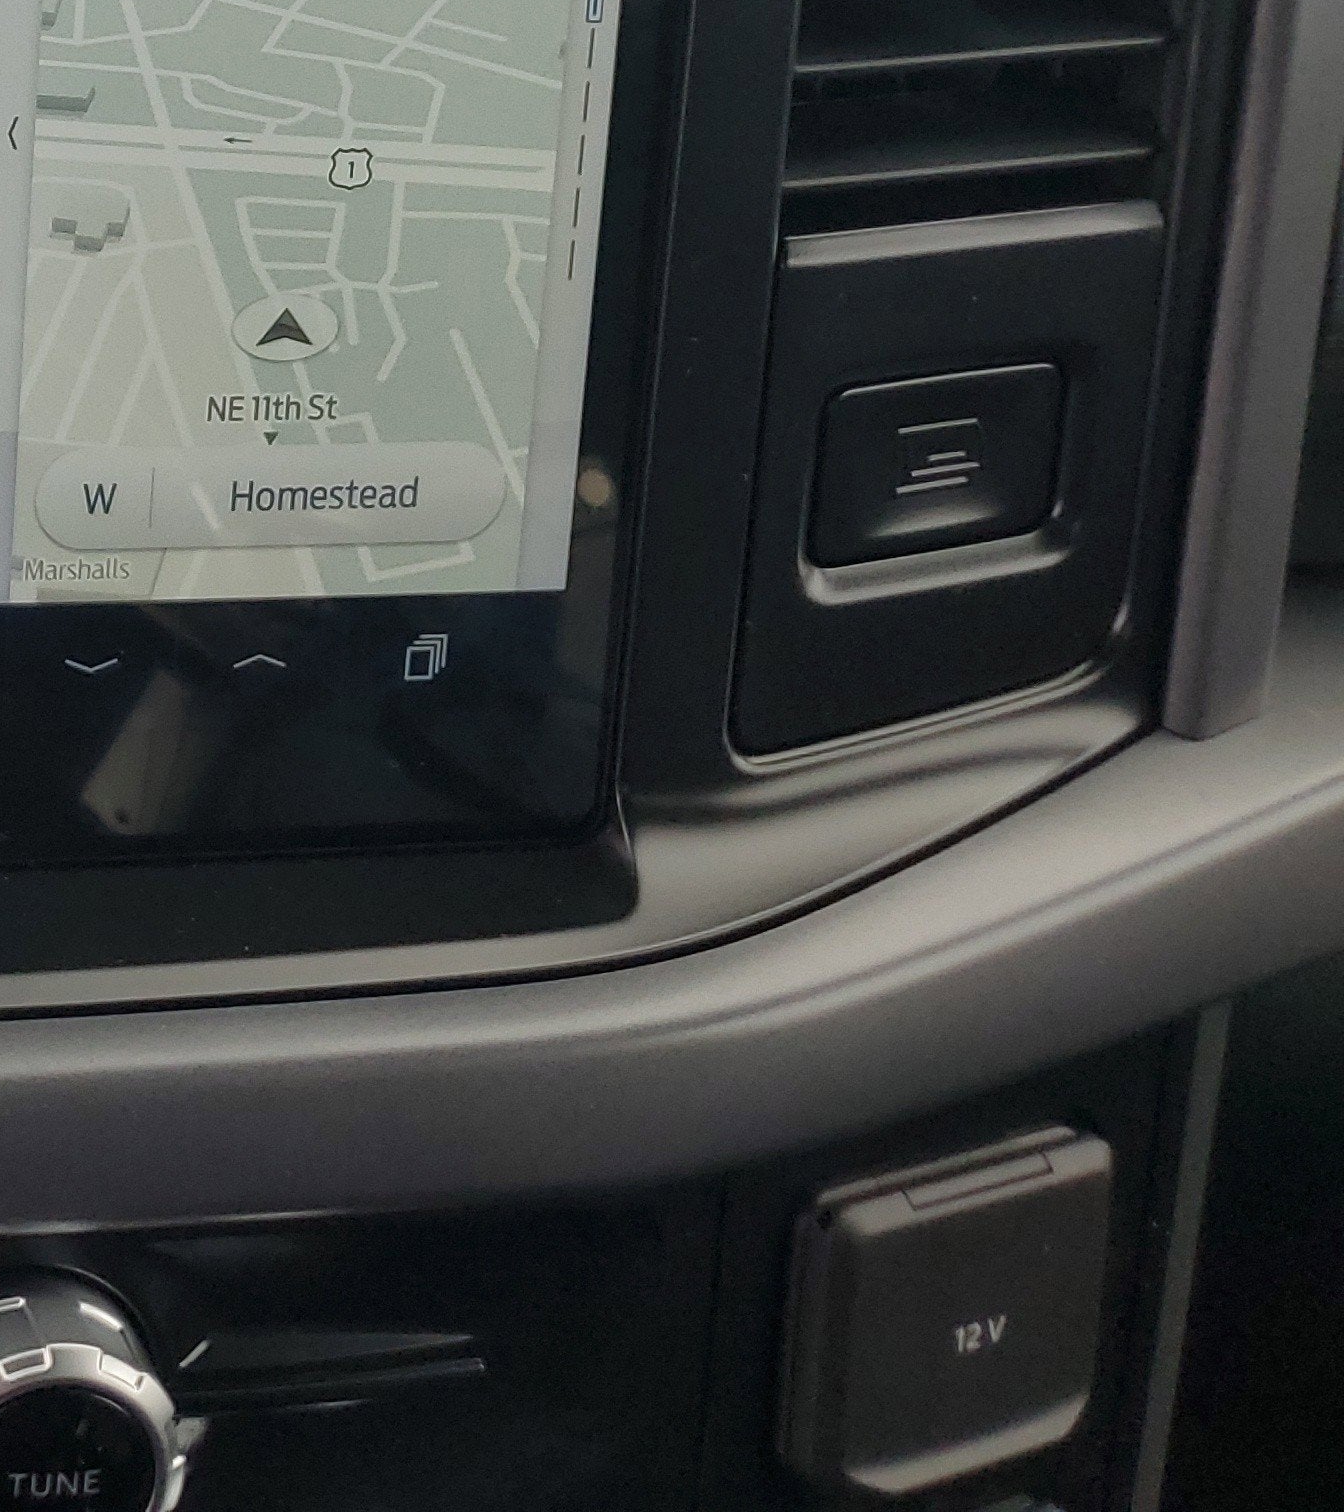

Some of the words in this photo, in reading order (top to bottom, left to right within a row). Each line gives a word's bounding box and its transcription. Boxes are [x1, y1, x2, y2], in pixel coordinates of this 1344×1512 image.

[206, 396, 245, 422] NE
[251, 394, 302, 422] 11th
[308, 394, 338, 421] St
[82, 482, 118, 515] W
[230, 476, 420, 513] Homestead
[24, 557, 131, 583] Marshalls
[956, 1323, 981, 1352] 12
[988, 1316, 1006, 1342] V
[8, 1468, 103, 1500] TUNE
